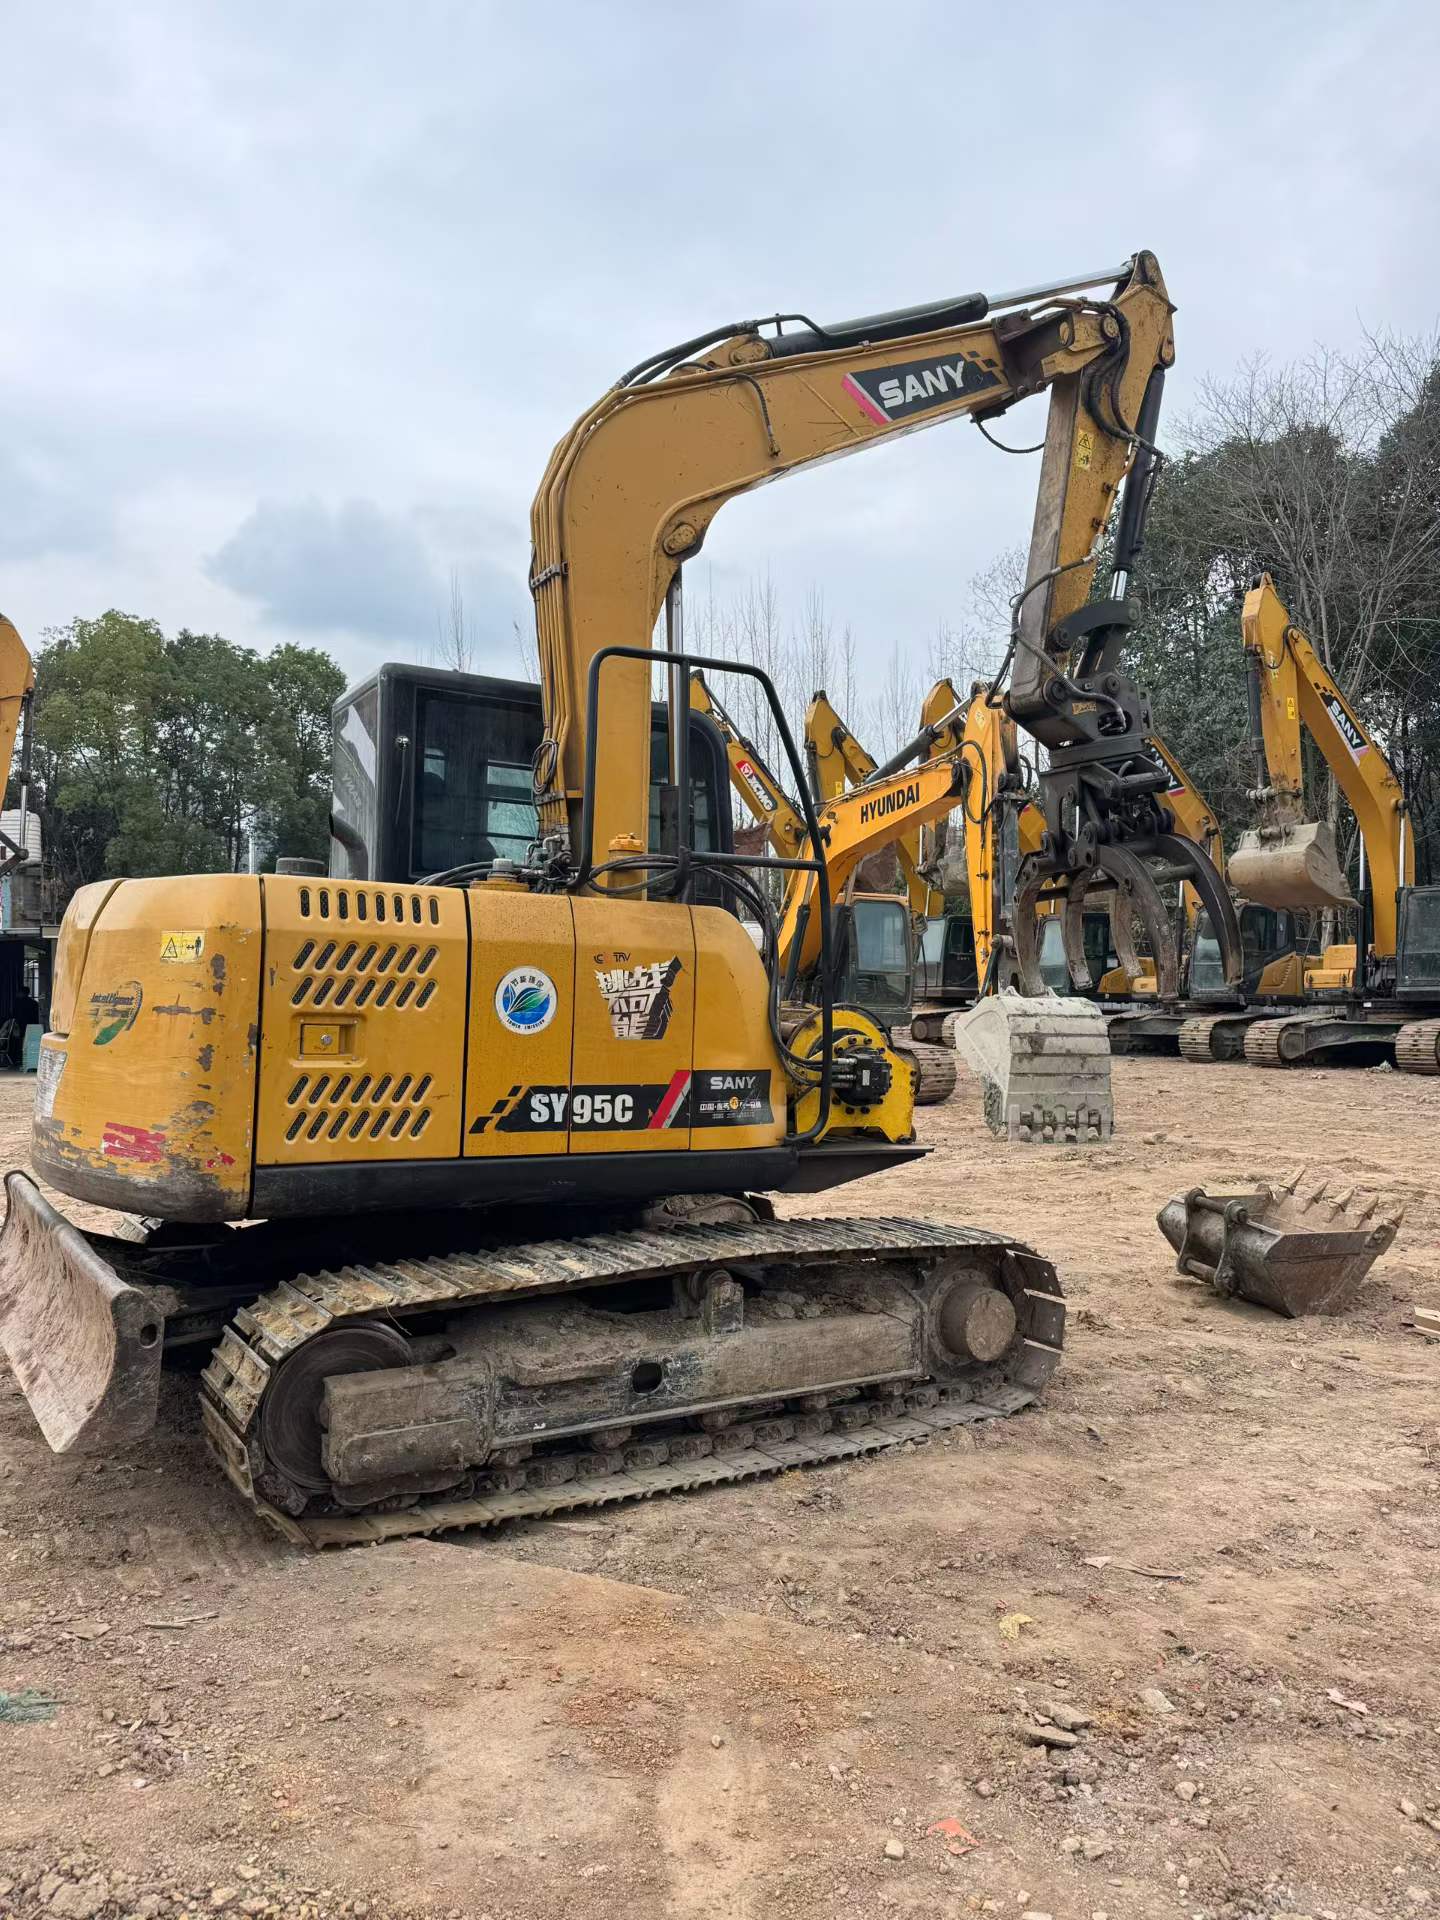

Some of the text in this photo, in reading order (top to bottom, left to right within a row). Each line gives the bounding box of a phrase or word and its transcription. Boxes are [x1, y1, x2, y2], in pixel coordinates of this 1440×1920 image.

[878, 360, 965, 409] SANY
[1330, 700, 1361, 745] SANY
[860, 782, 920, 824] HYUNDAI
[593, 952, 632, 965] CTV
[710, 1076, 756, 1090] SANY
